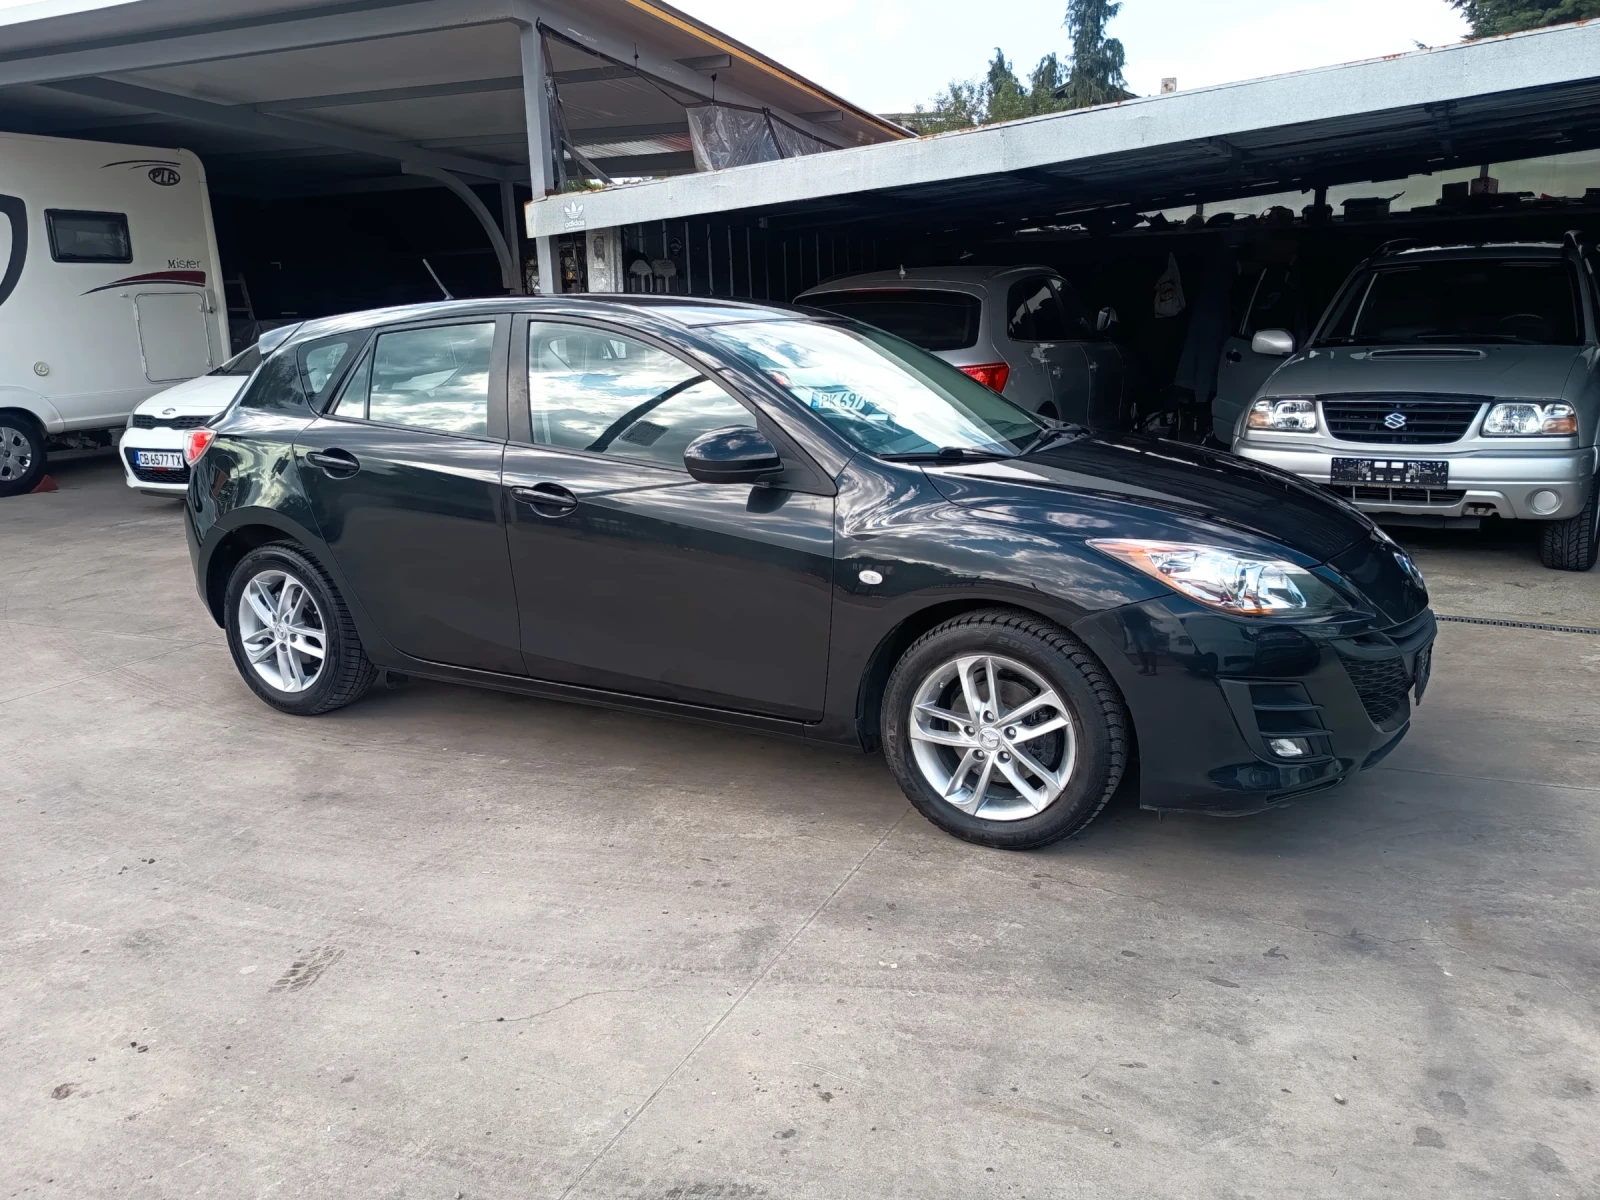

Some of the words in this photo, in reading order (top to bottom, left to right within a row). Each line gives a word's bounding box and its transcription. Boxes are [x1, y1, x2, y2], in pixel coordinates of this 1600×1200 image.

[151, 169, 178, 184] PLA
[564, 219, 585, 228] adidas
[167, 257, 202, 269] Mister
[821, 394, 837, 407] PK
[840, 393, 866, 408] 697
[139, 453, 150, 465] CB
[150, 453, 169, 466] 6577
[170, 454, 183, 467] TX
